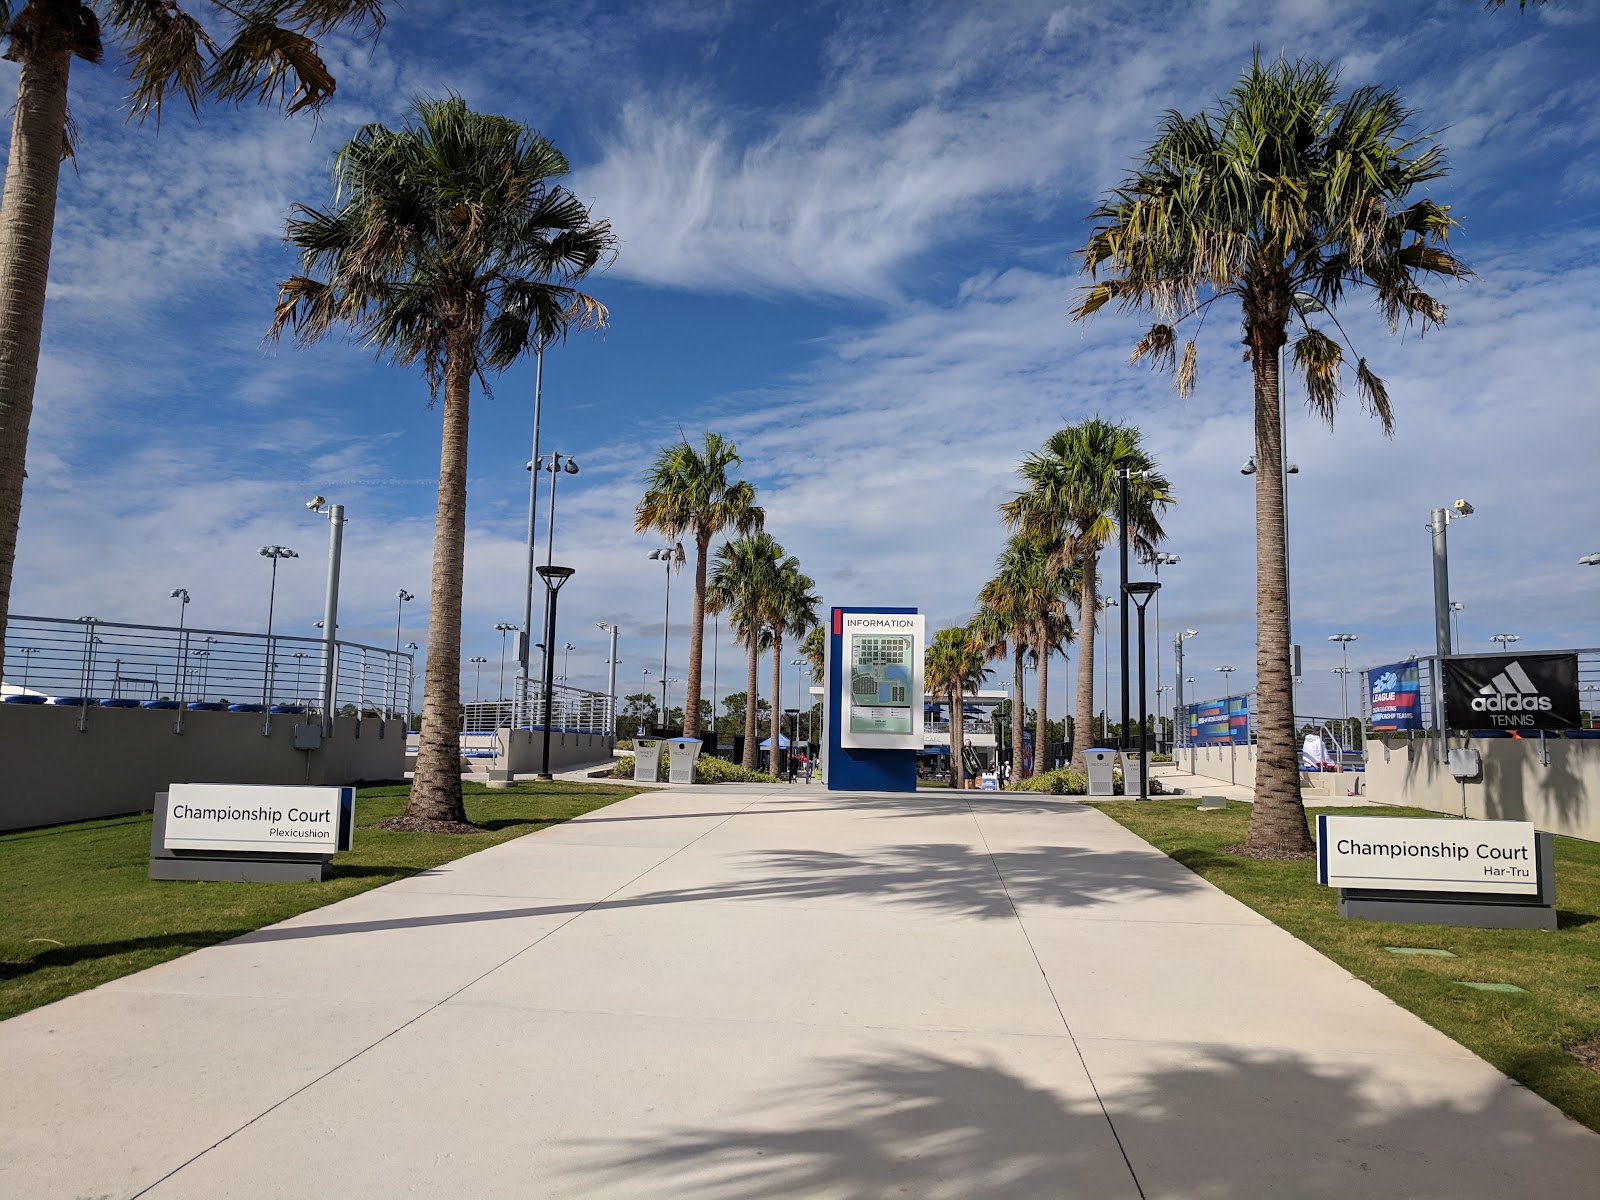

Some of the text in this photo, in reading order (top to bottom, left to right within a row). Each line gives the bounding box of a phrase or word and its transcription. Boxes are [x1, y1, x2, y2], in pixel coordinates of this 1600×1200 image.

[847, 619, 914, 628] INFORMATION
[1372, 692, 1395, 703] LEAGUE
[1471, 693, 1552, 712] adidas
[1489, 714, 1535, 726] TENNIS
[173, 804, 331, 824] Championship Court
[269, 827, 330, 838] Plexicushion
[1337, 839, 1528, 861] Championship Court
[1484, 865, 1530, 877] Har-Tru
